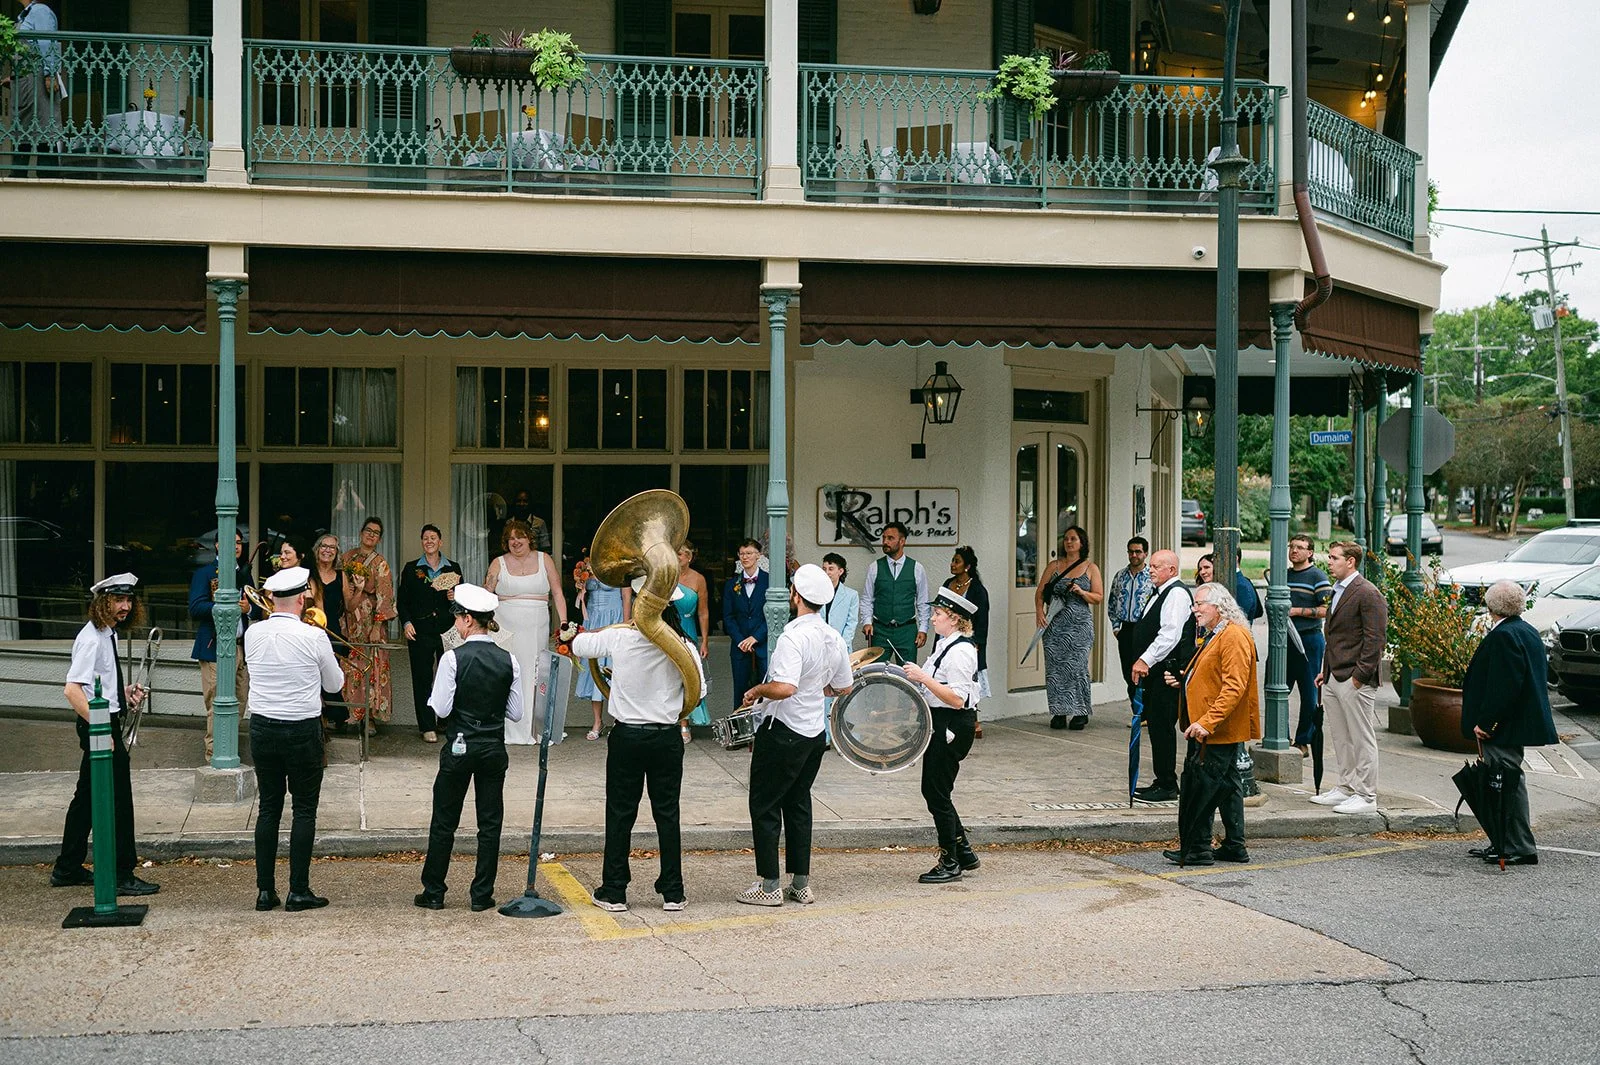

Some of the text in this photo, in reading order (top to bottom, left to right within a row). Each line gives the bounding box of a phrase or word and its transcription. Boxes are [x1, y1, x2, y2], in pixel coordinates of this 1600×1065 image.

[1313, 433, 1350, 443] Dumaine
[834, 489, 951, 541] Ralph's
[906, 527, 923, 537] he
[927, 526, 957, 538] Park
